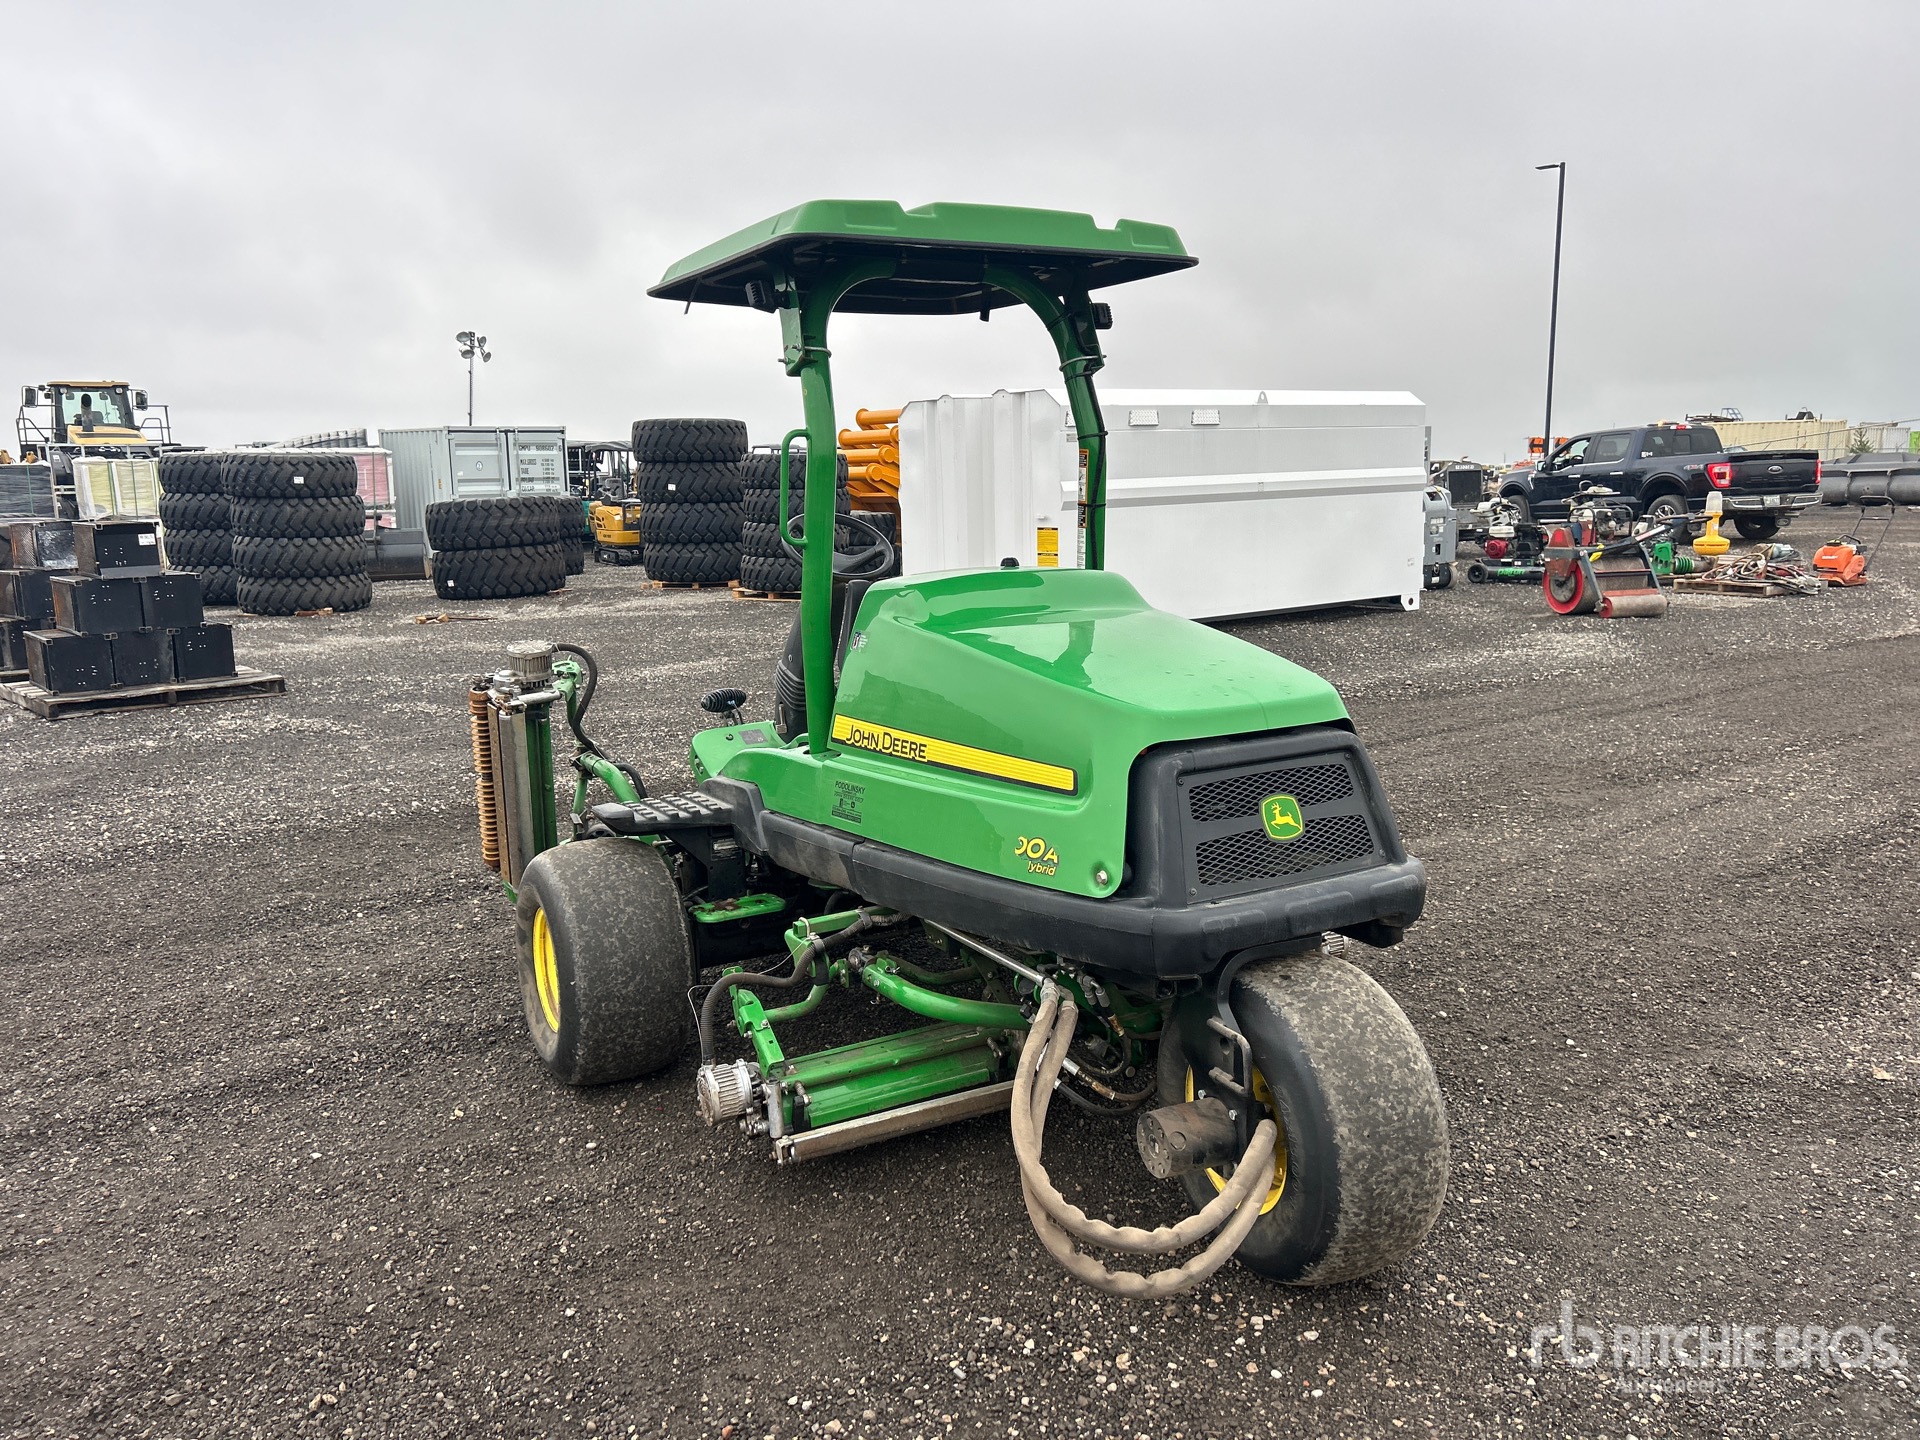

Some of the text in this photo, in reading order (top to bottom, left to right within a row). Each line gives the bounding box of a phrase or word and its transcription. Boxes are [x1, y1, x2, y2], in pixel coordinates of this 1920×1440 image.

[845, 724, 928, 759] JOHN DEERE
[834, 780, 866, 795] PODOLINSKY
